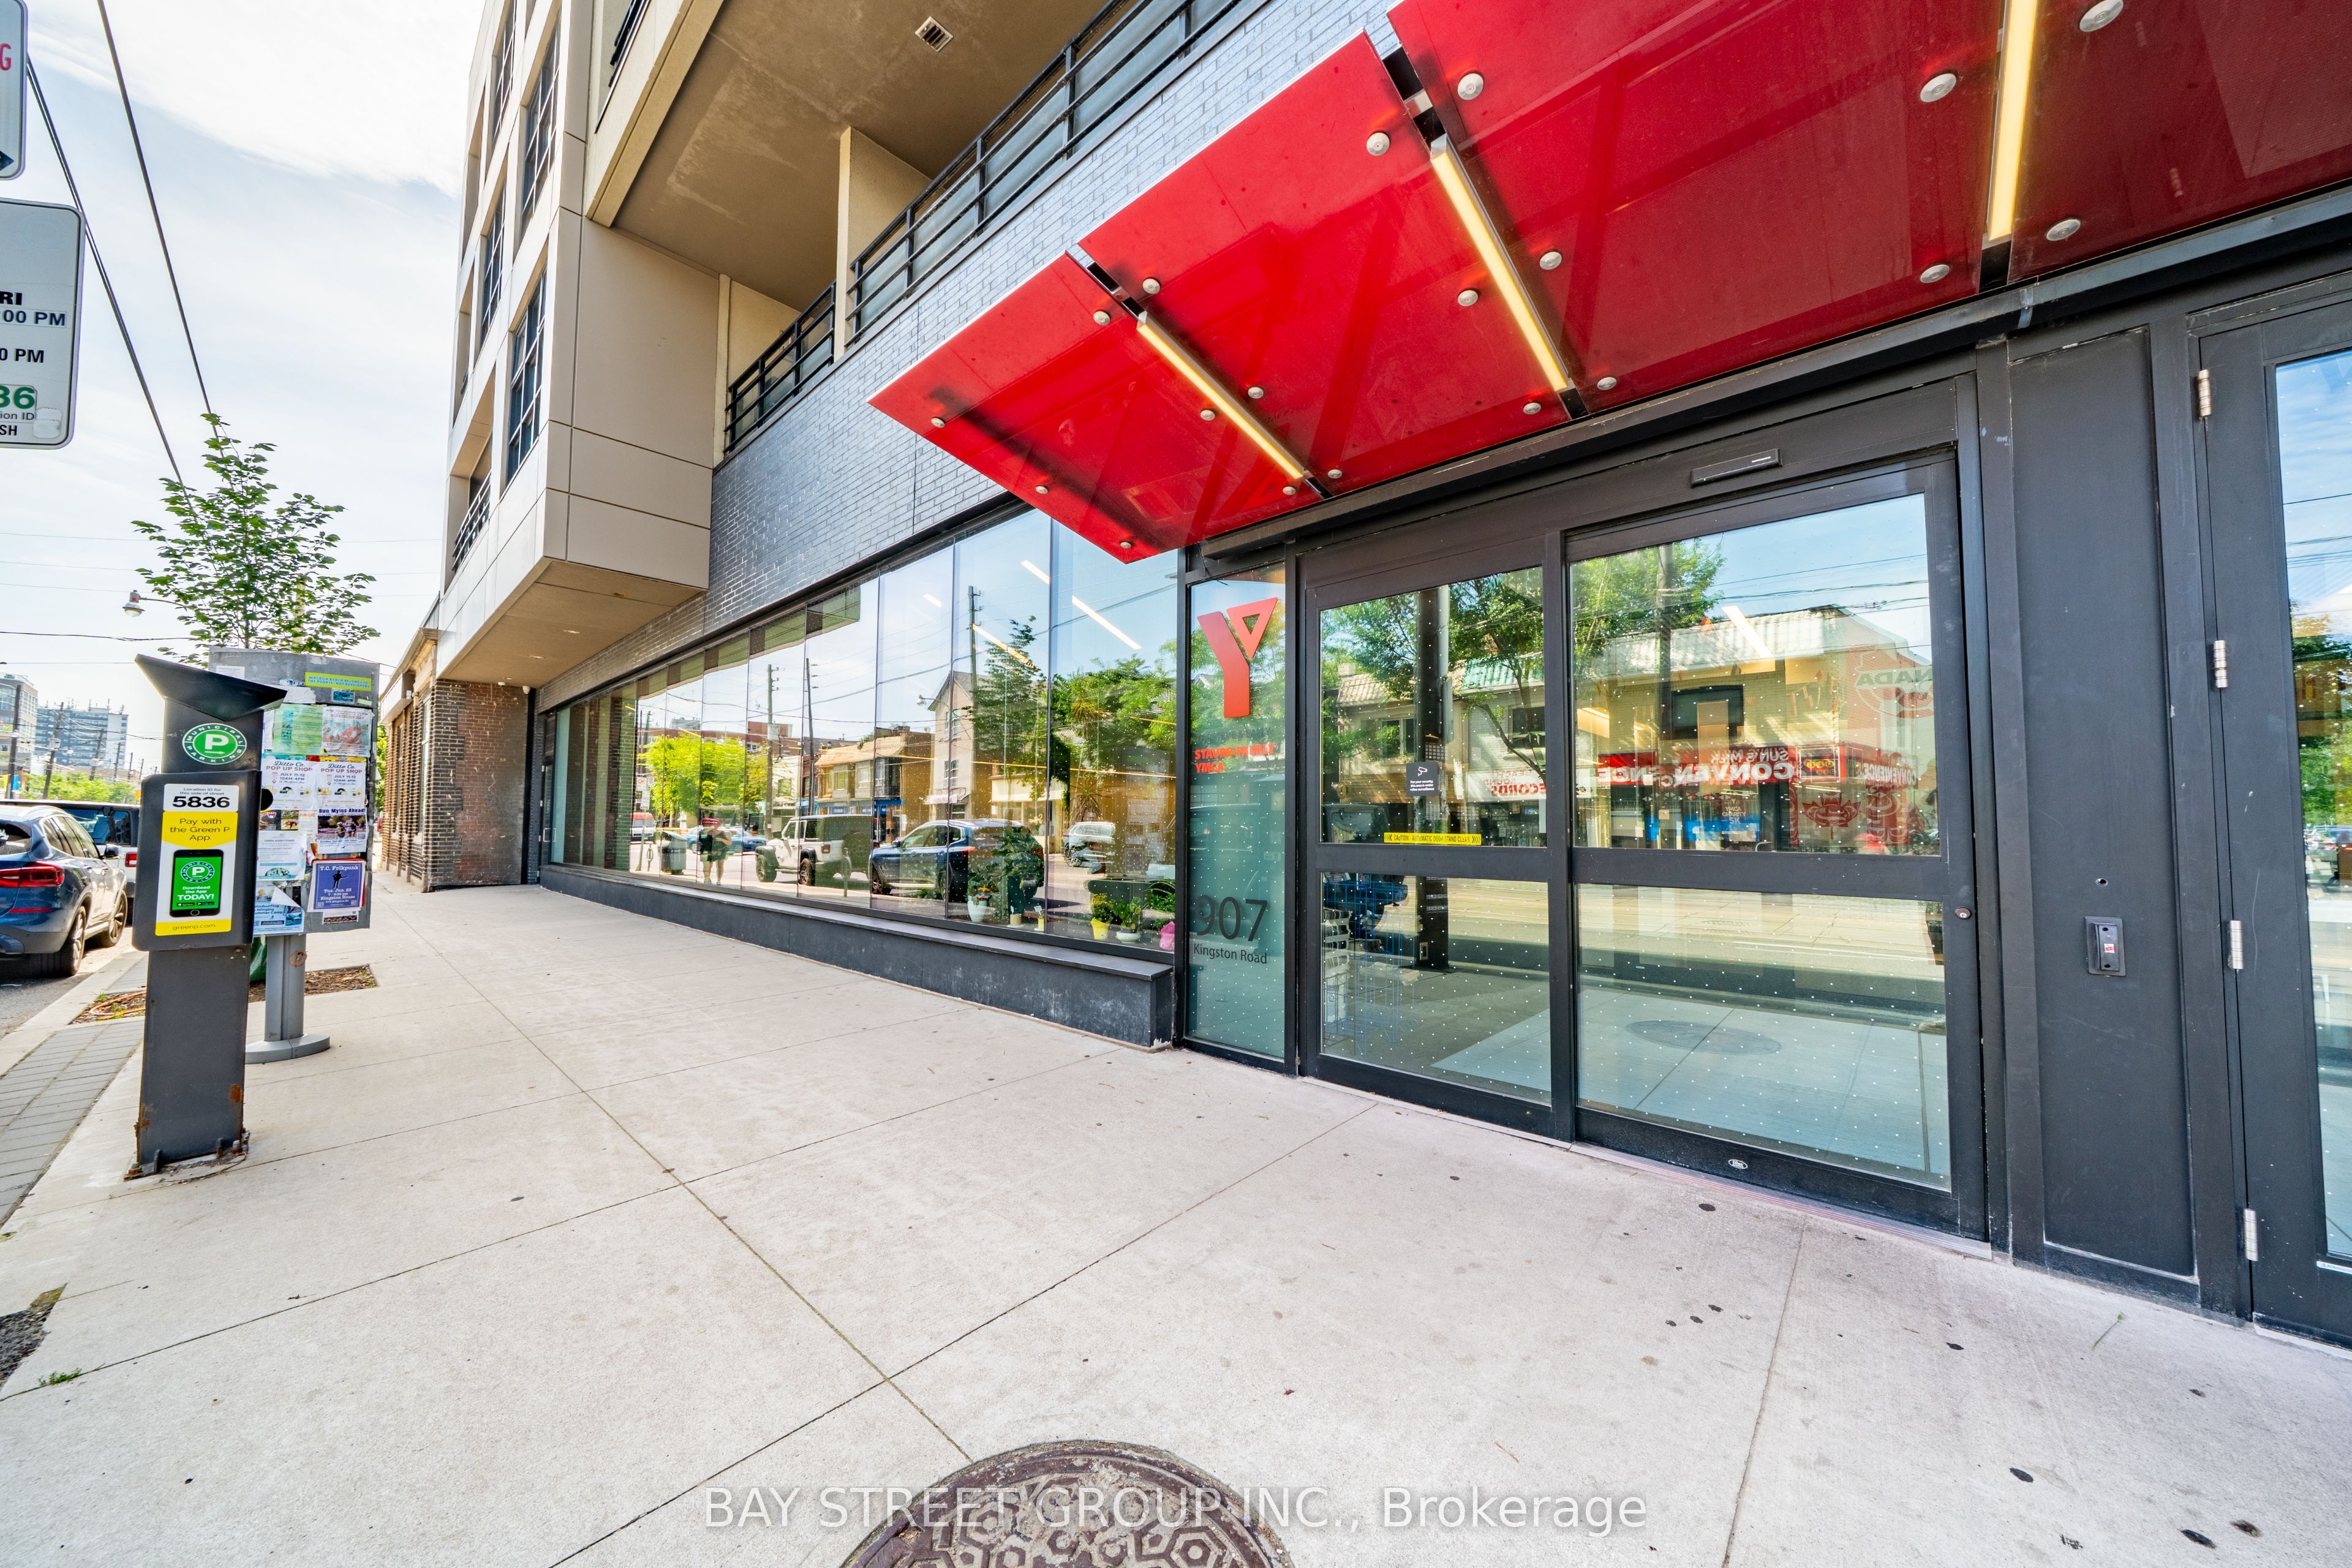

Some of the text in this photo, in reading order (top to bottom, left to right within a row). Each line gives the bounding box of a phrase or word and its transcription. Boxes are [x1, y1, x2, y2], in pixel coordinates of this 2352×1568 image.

[0, 310, 66, 326] 00 PM
[15, 348, 44, 363] PM
[187, 725, 243, 744] MUNICIPAL
[187, 745, 243, 763] PARKING
[1195, 742, 1276, 760] STAVRO FAMILY
[1195, 761, 1224, 774] YMCA
[172, 796, 230, 808] 5836
[1194, 894, 1268, 942] 907
[1194, 943, 1267, 965] Kingston Road
